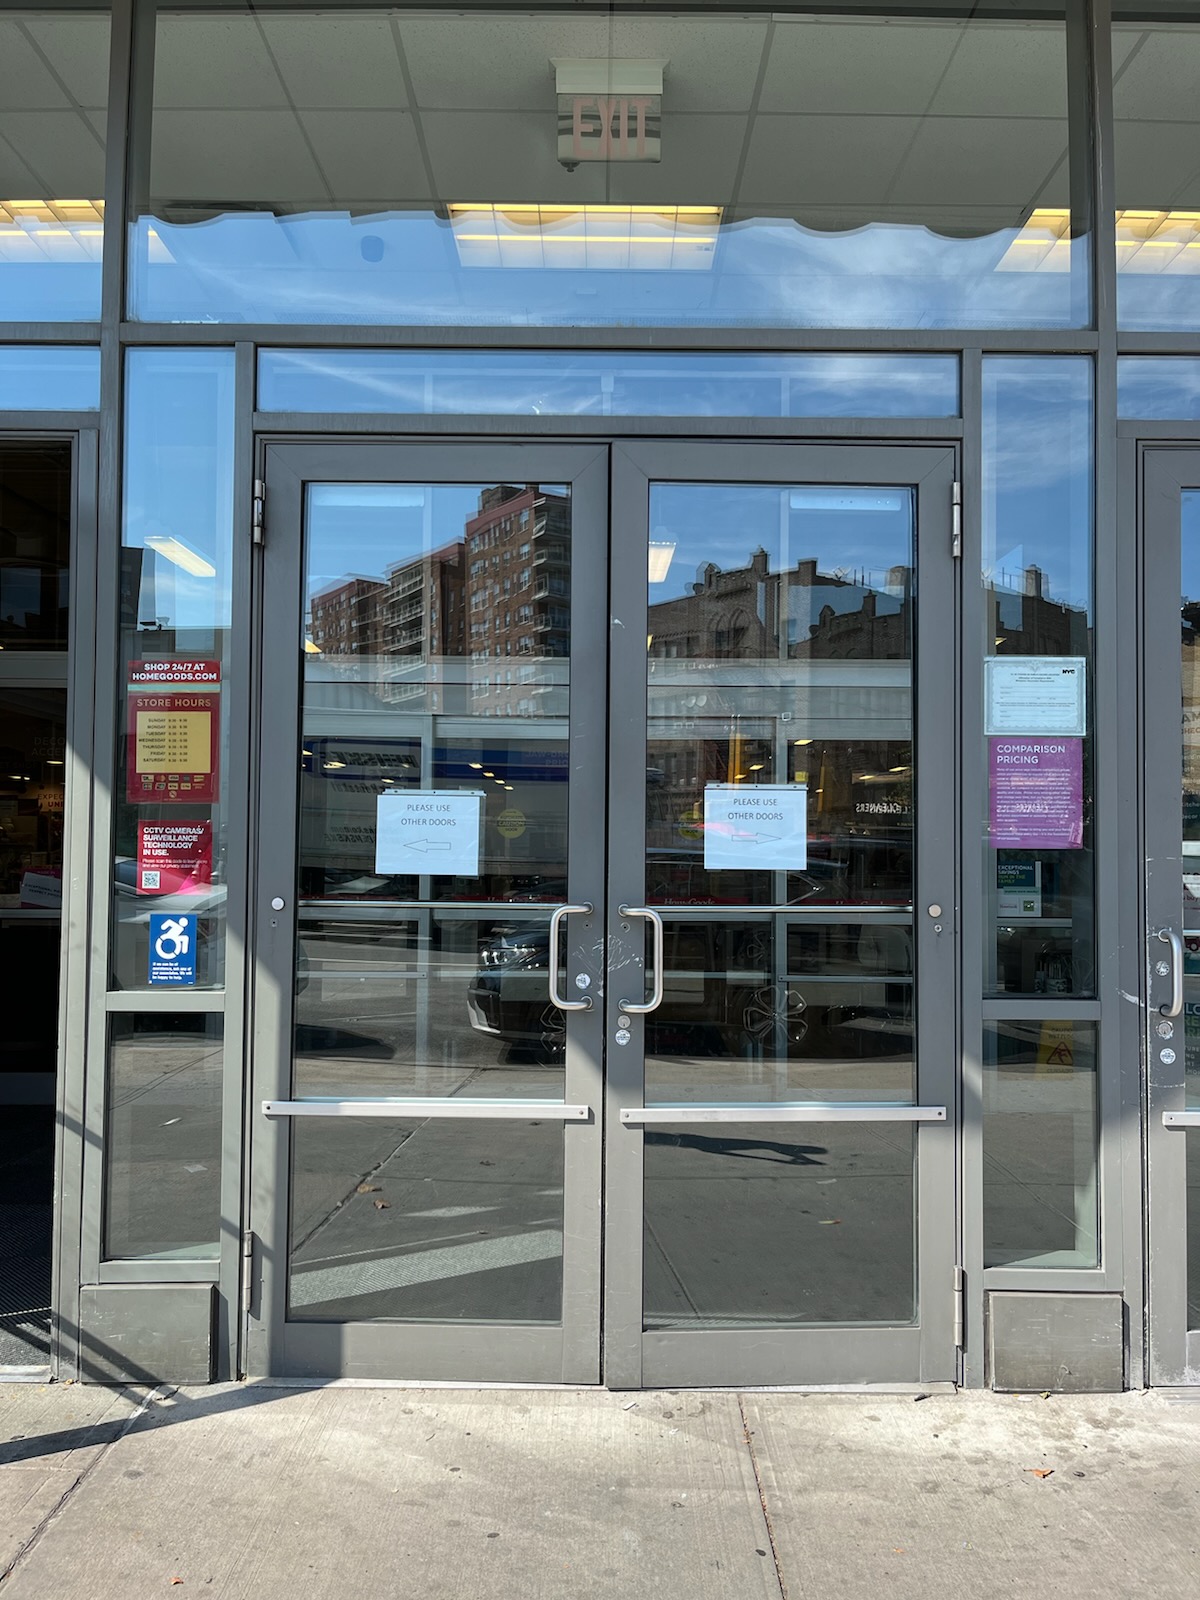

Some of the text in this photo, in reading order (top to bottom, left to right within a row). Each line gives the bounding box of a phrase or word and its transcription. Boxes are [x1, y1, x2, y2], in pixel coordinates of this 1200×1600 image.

[572, 98, 652, 158] EXIT
[144, 663, 206, 671] SHOP 24/7 AT
[132, 672, 217, 681] HOMEGOODS.COM
[136, 698, 212, 707] STORE HOURS
[996, 744, 1066, 754] COMPARISON
[996, 755, 1039, 764] PRICING
[733, 798, 778, 806] PLEASE USE
[407, 804, 451, 812] PLEASE USE
[727, 812, 784, 821] OTHER DOORS
[400, 818, 457, 827] OTHER DOORS
[143, 834, 199, 842] SURVEILLANCE
